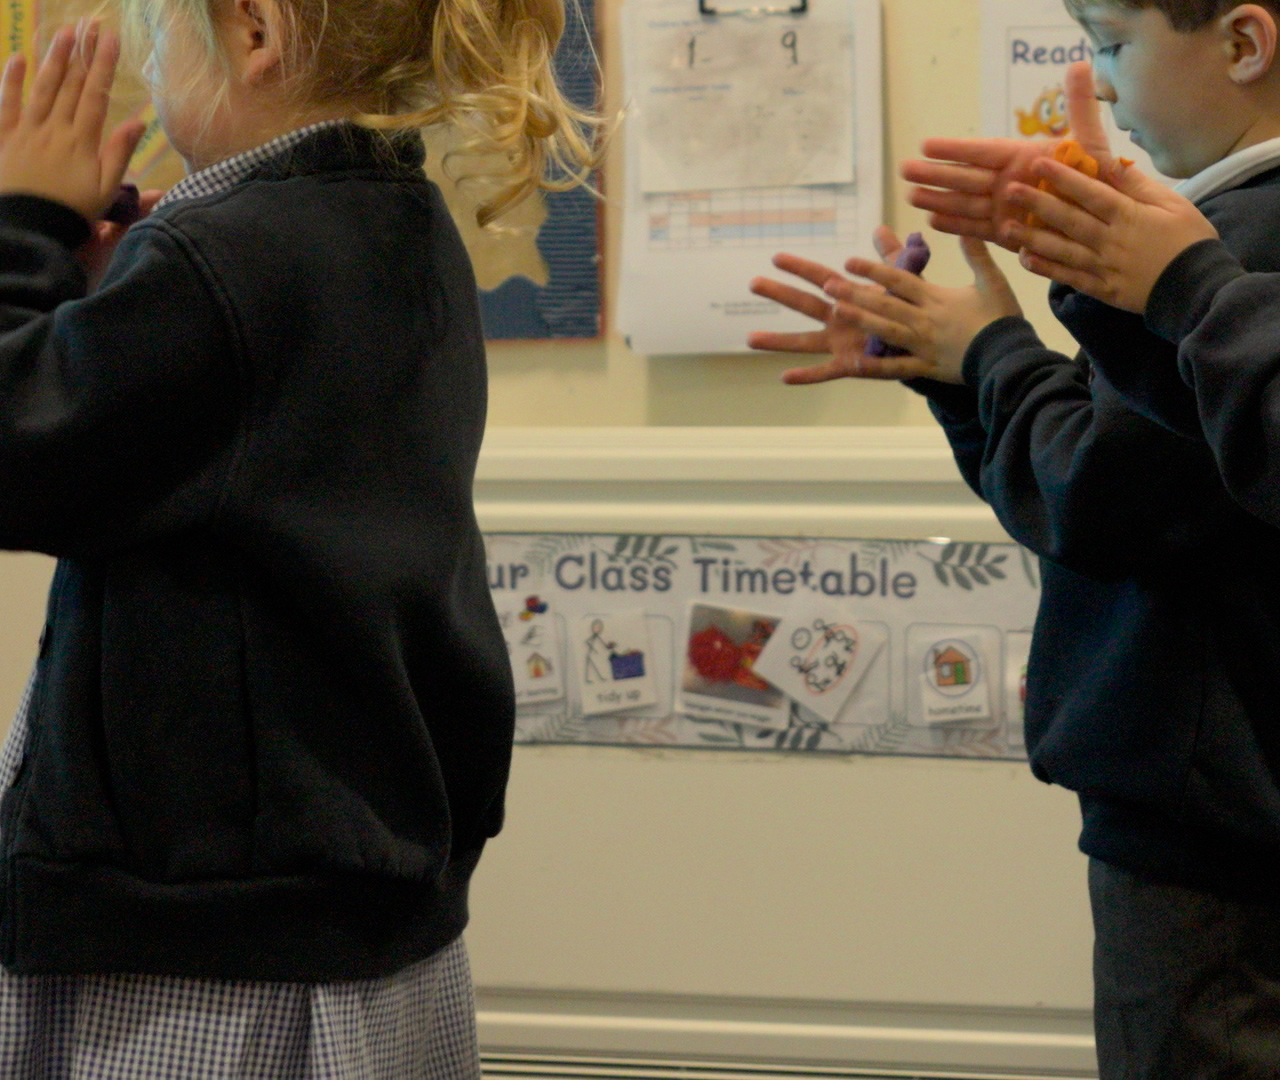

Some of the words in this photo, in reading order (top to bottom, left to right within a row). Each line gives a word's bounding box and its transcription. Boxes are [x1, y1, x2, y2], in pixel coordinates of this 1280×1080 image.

[687, 36, 696, 67] 1
[781, 30, 798, 65] 9
[489, 563, 529, 590] ur
[555, 552, 672, 592] Class
[693, 553, 917, 599] Timetable
